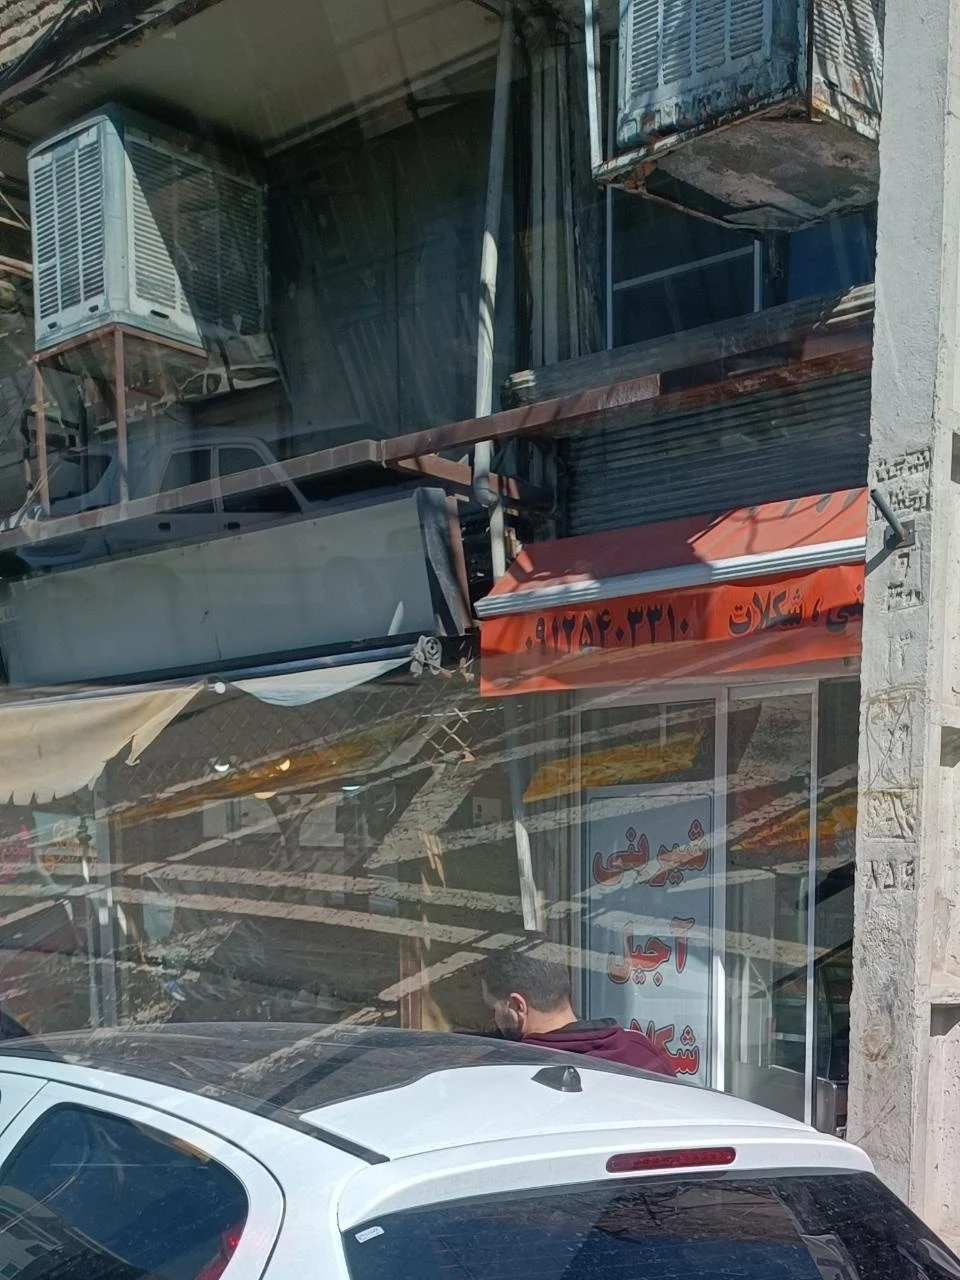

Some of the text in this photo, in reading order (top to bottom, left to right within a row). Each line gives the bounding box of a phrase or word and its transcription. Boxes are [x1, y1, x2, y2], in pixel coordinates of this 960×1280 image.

[728, 587, 804, 636] شکلات
[594, 820, 708, 887] شیرینی
[606, 917, 695, 986] آجیل
